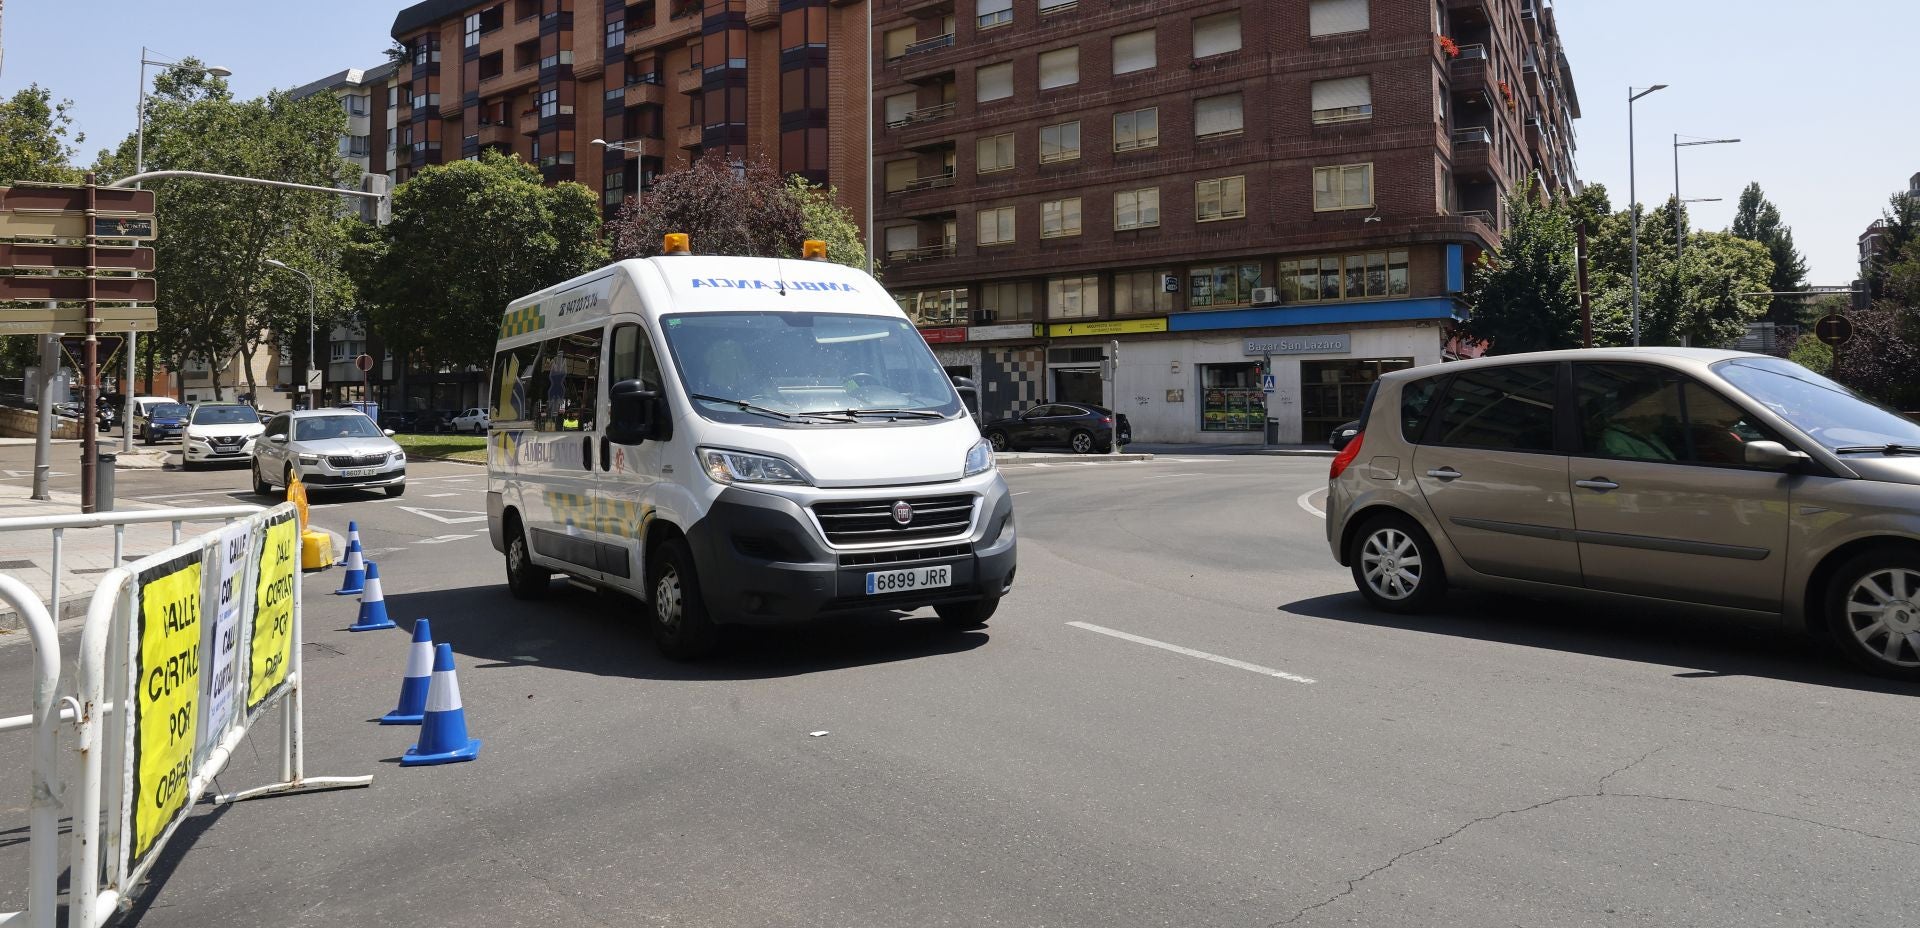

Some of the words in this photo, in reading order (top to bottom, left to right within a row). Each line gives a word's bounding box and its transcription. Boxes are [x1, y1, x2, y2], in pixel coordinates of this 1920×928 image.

[1248, 341, 1278, 351] Bazar
[1280, 340, 1301, 350] San
[524, 440, 584, 466] AMBULANCI
[898, 508, 909, 519] FIAT
[877, 572, 915, 590] 6899
[920, 568, 947, 586] JRR
